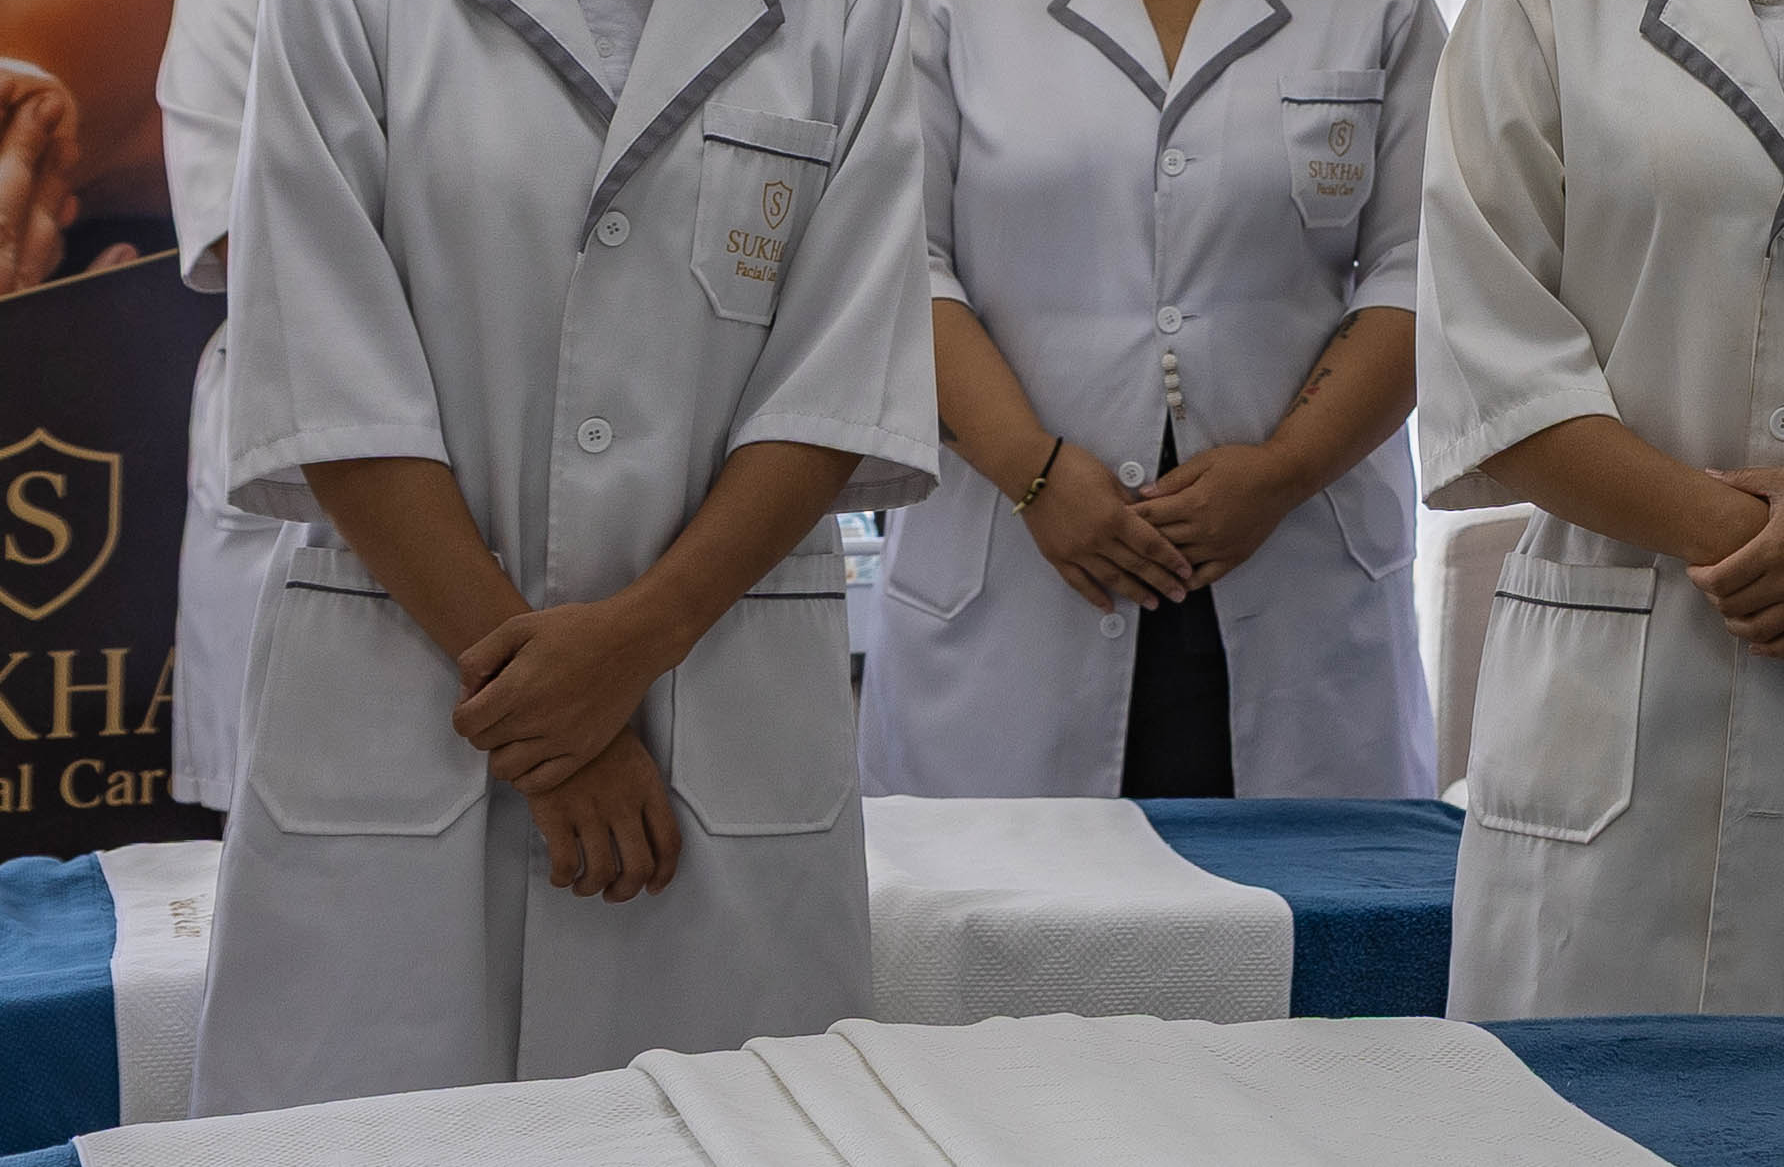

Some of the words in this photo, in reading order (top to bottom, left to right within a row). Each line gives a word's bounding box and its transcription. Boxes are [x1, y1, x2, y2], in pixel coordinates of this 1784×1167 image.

[769, 191, 783, 217] S
[4, 470, 72, 565] S
[59, 758, 173, 809] Car
